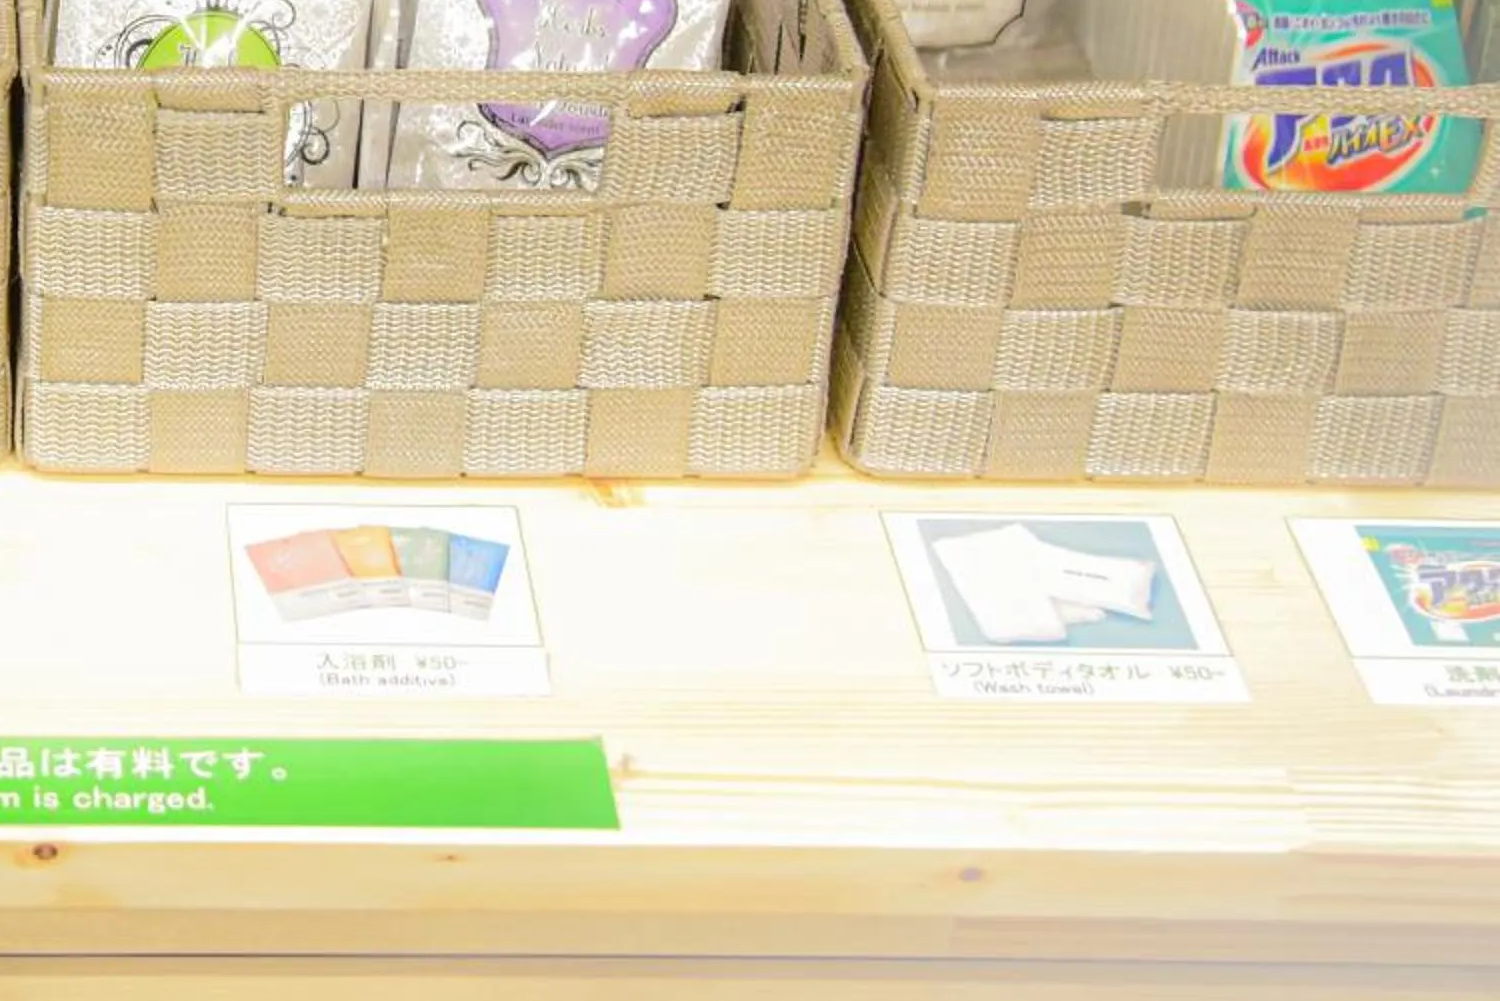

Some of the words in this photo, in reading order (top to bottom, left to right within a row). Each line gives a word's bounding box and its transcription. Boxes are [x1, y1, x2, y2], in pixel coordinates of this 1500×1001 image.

[316, 653, 397, 672] 入浴剤
[941, 660, 1152, 681] ソフトボディタオル
[319, 672, 371, 687] (Bath
[32, 785, 61, 809] is
[72, 786, 216, 814] charged.
